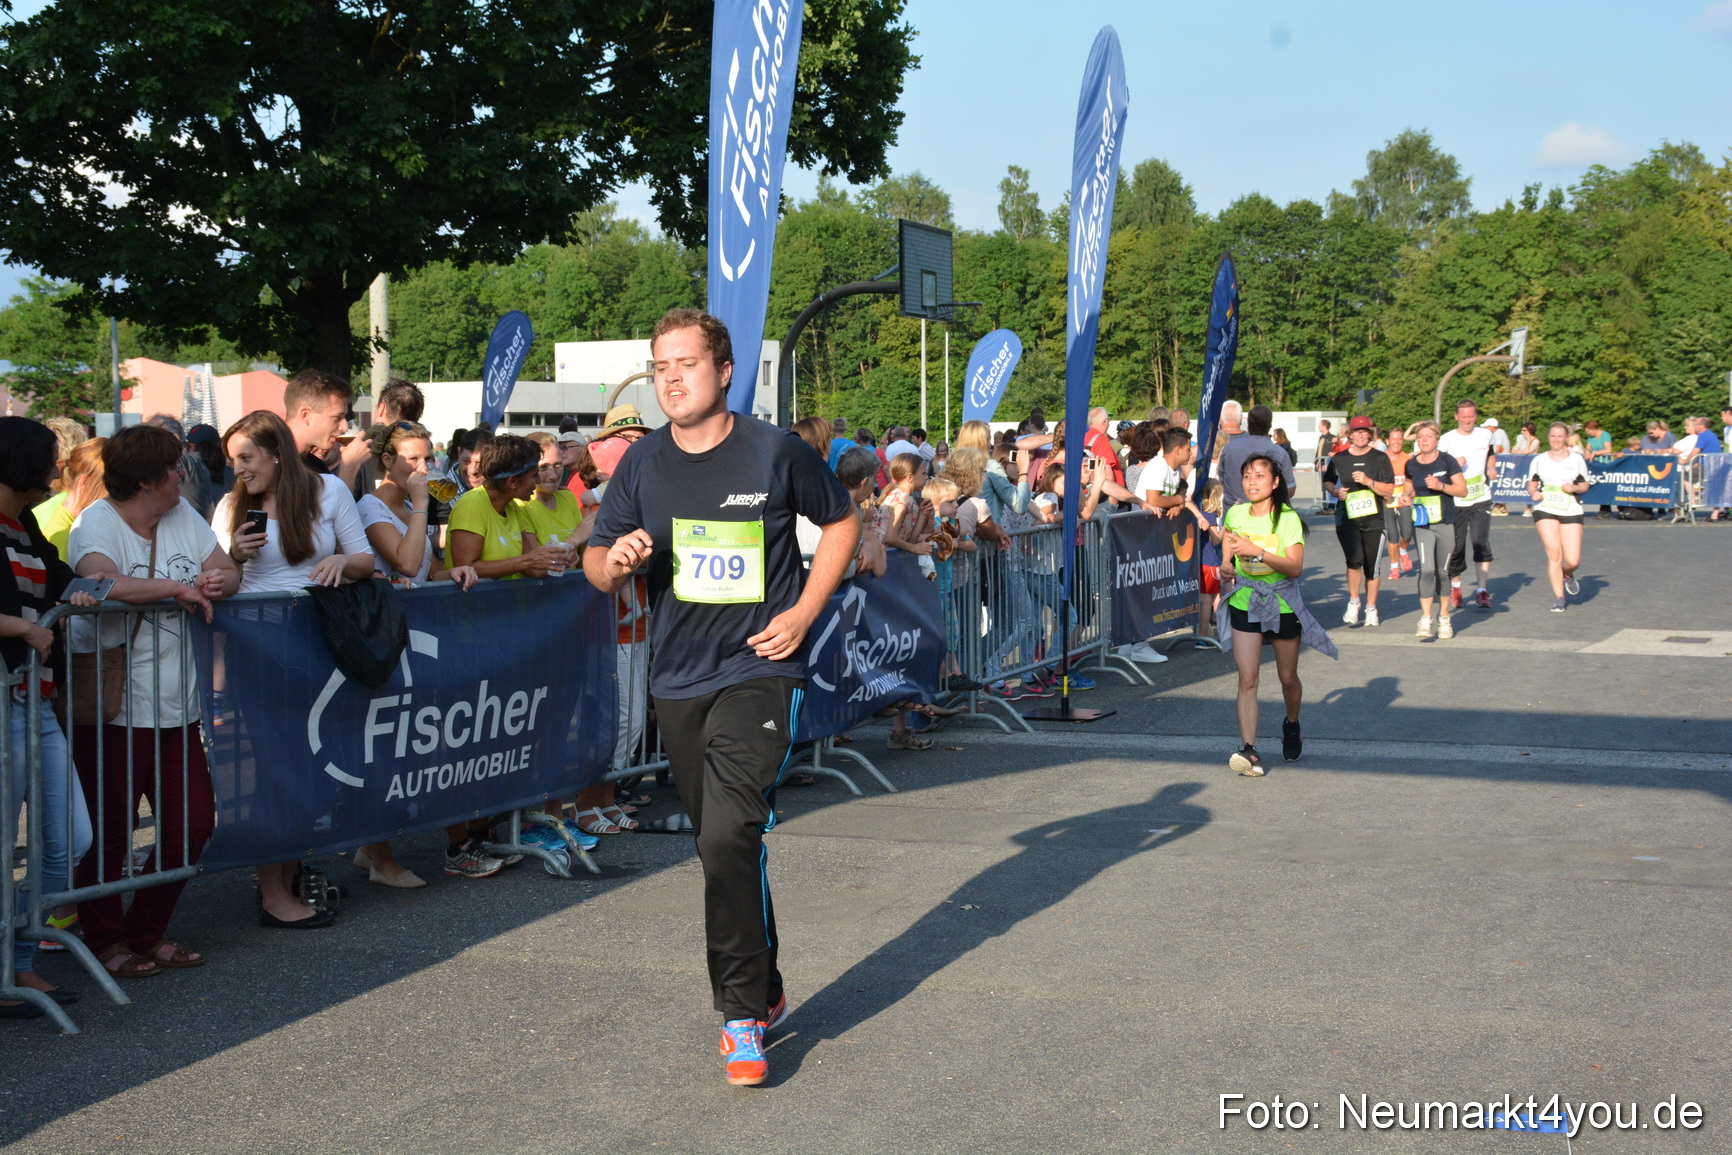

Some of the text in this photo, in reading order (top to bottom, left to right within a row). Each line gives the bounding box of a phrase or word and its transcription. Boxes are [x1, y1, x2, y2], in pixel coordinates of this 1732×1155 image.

[492, 325, 523, 395] Fischer
[501, 338, 526, 394] AUTOMOBILE
[978, 341, 1010, 398] Fischer
[990, 352, 1014, 397] AUTOMOBILE
[1349, 499, 1373, 512] 1229
[1494, 489, 1530, 497] AUTOMO
[1548, 492, 1564, 503] 389
[691, 553, 745, 580] 709
[1151, 586, 1166, 601] Druck
[1166, 580, 1178, 598] und
[842, 623, 921, 677] Fischer
[364, 679, 548, 764] Fischer
[384, 745, 532, 803] AUTOMOBILE
